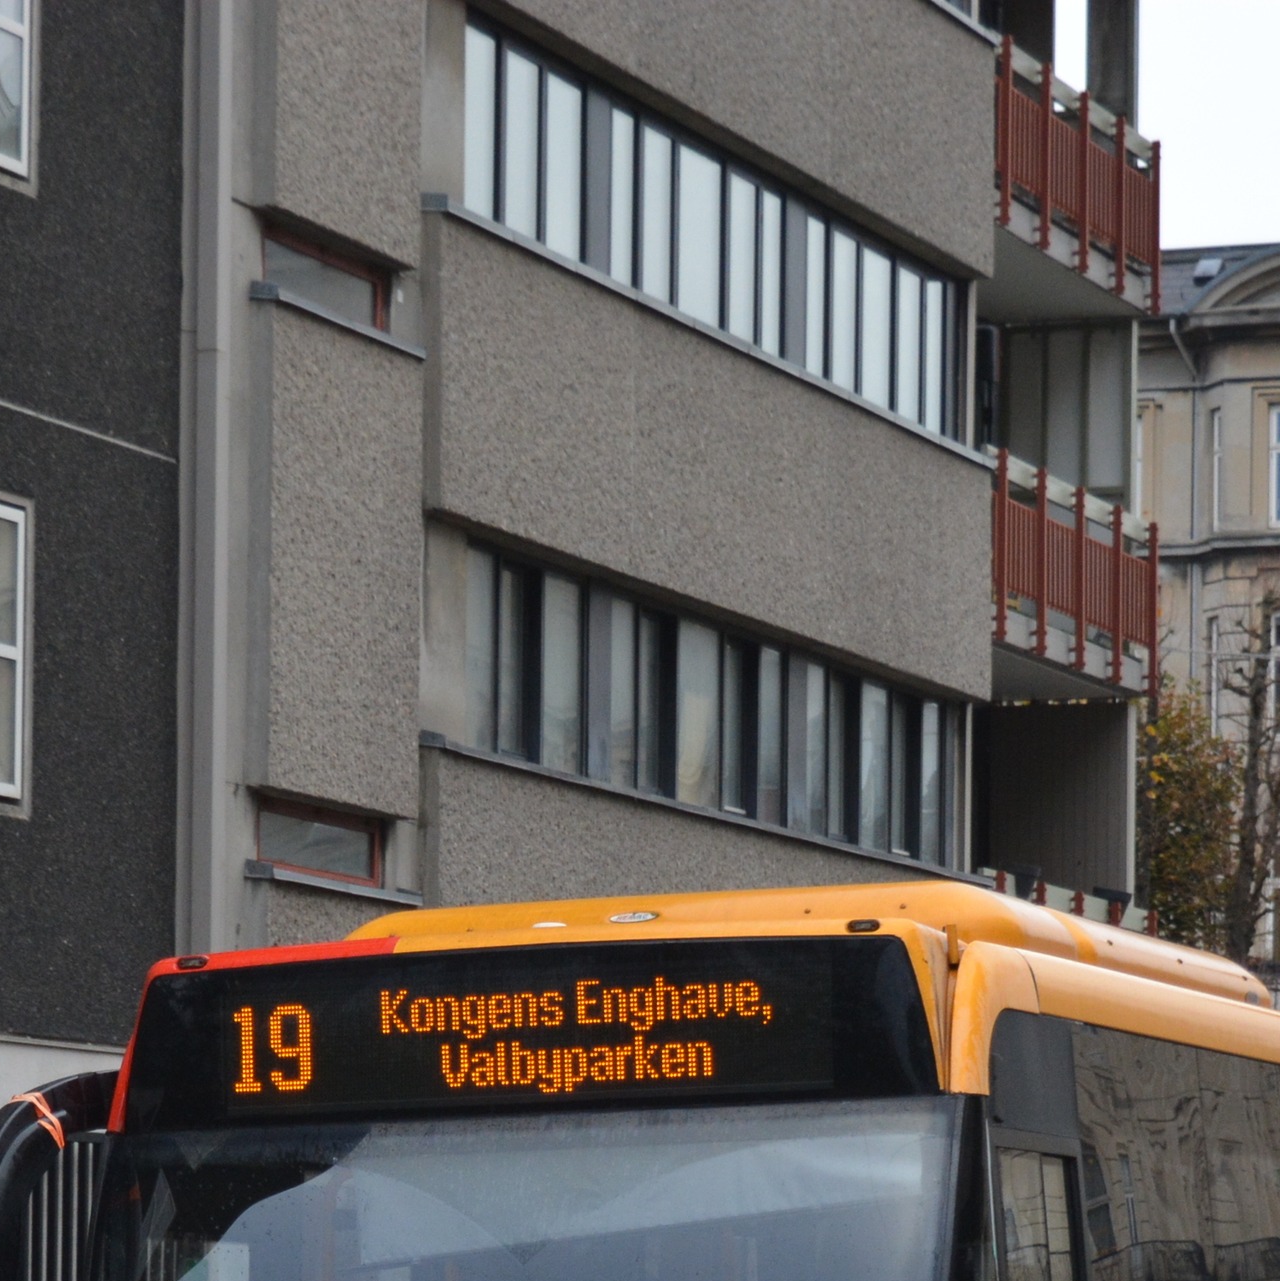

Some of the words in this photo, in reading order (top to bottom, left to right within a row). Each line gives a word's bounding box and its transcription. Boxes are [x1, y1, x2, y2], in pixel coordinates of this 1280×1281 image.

[380, 988, 565, 1040] Kongens
[576, 977, 773, 1031] Enghave,
[232, 1003, 313, 1094] 19
[440, 1036, 714, 1093] Valbyparken
